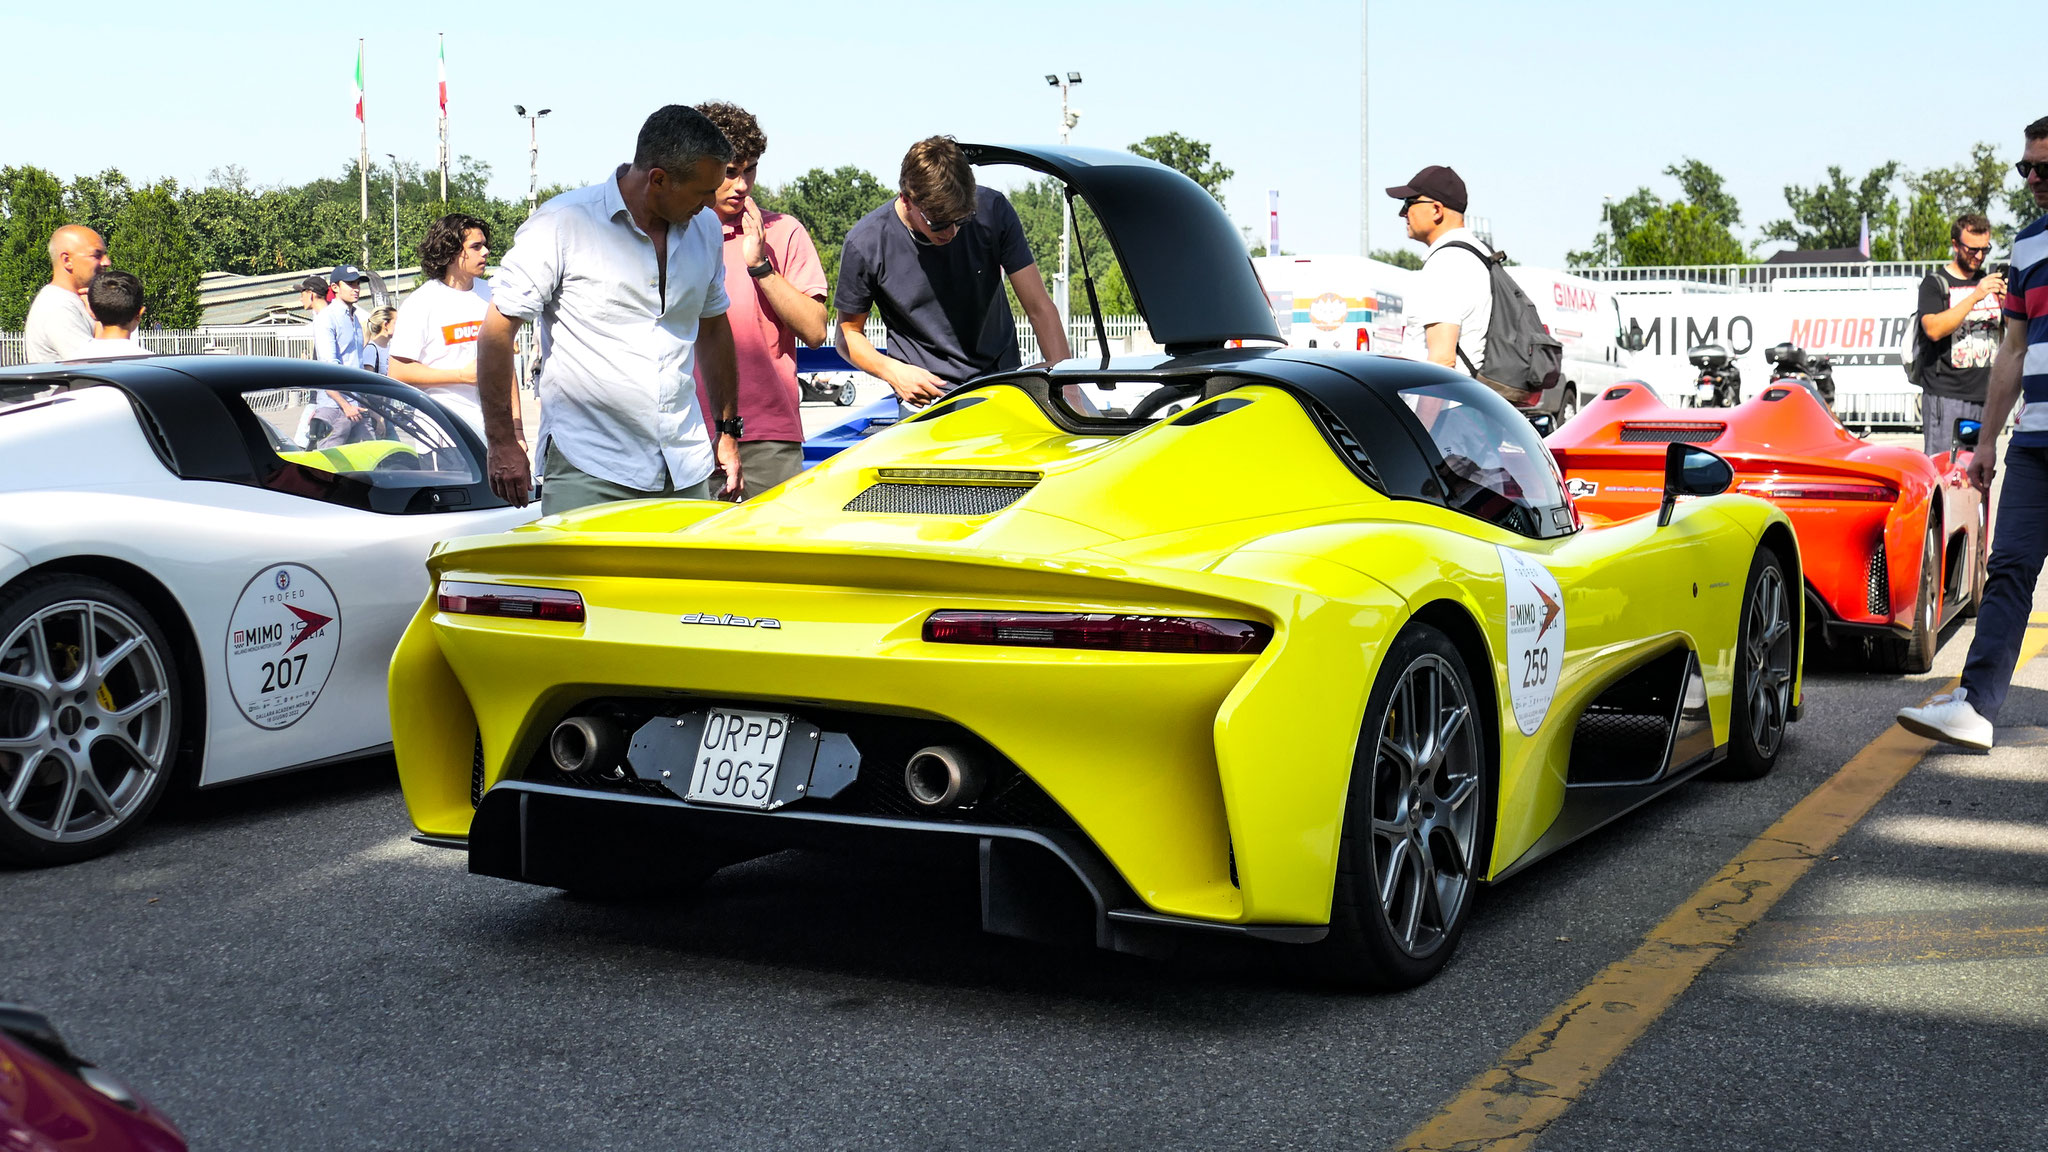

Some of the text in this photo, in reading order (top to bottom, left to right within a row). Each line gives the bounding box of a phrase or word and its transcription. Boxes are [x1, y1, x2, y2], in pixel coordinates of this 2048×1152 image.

[1554, 283, 1597, 312] GIMAX
[454, 325, 482, 340] DUC
[1630, 316, 1752, 355] MIMO
[262, 589, 305, 604] TROFEO
[680, 612, 782, 629] dallara
[1515, 603, 1536, 626] MIMO
[246, 623, 283, 647] MIMO
[261, 653, 308, 694] 207
[1522, 647, 1549, 689] 259
[699, 756, 774, 800] 1963
